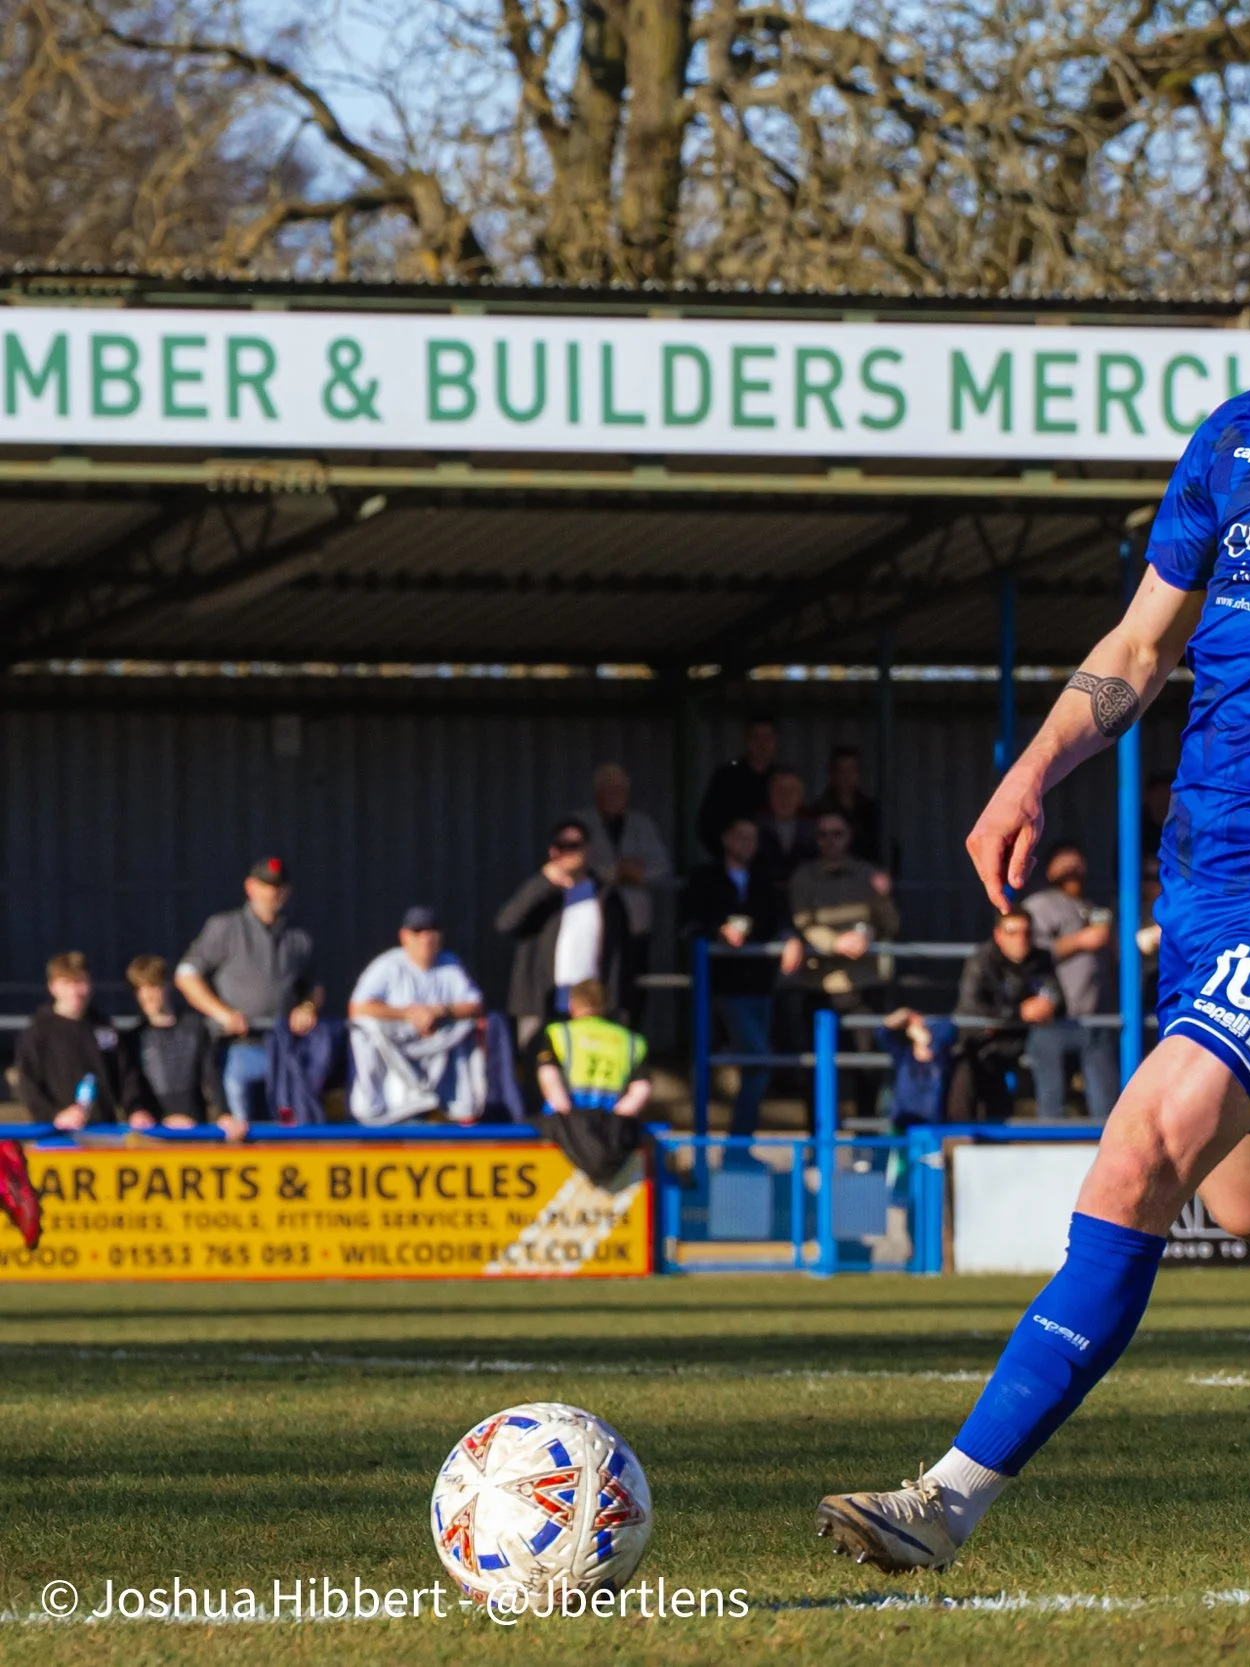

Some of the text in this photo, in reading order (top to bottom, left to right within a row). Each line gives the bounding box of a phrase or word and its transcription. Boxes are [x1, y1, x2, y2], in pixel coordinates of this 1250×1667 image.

[4, 332, 279, 420] MBER
[321, 337, 382, 421] &
[426, 339, 908, 432] BUILDERS
[38, 1163, 538, 1201] AR PARTS & BICYCLES
[276, 1209, 371, 1229] FITTING
[108, 1243, 193, 1267] 01553
[204, 1242, 251, 1266] 765
[1220, 1241, 1248, 1260] TO
[1033, 1314, 1091, 1351] capelli
